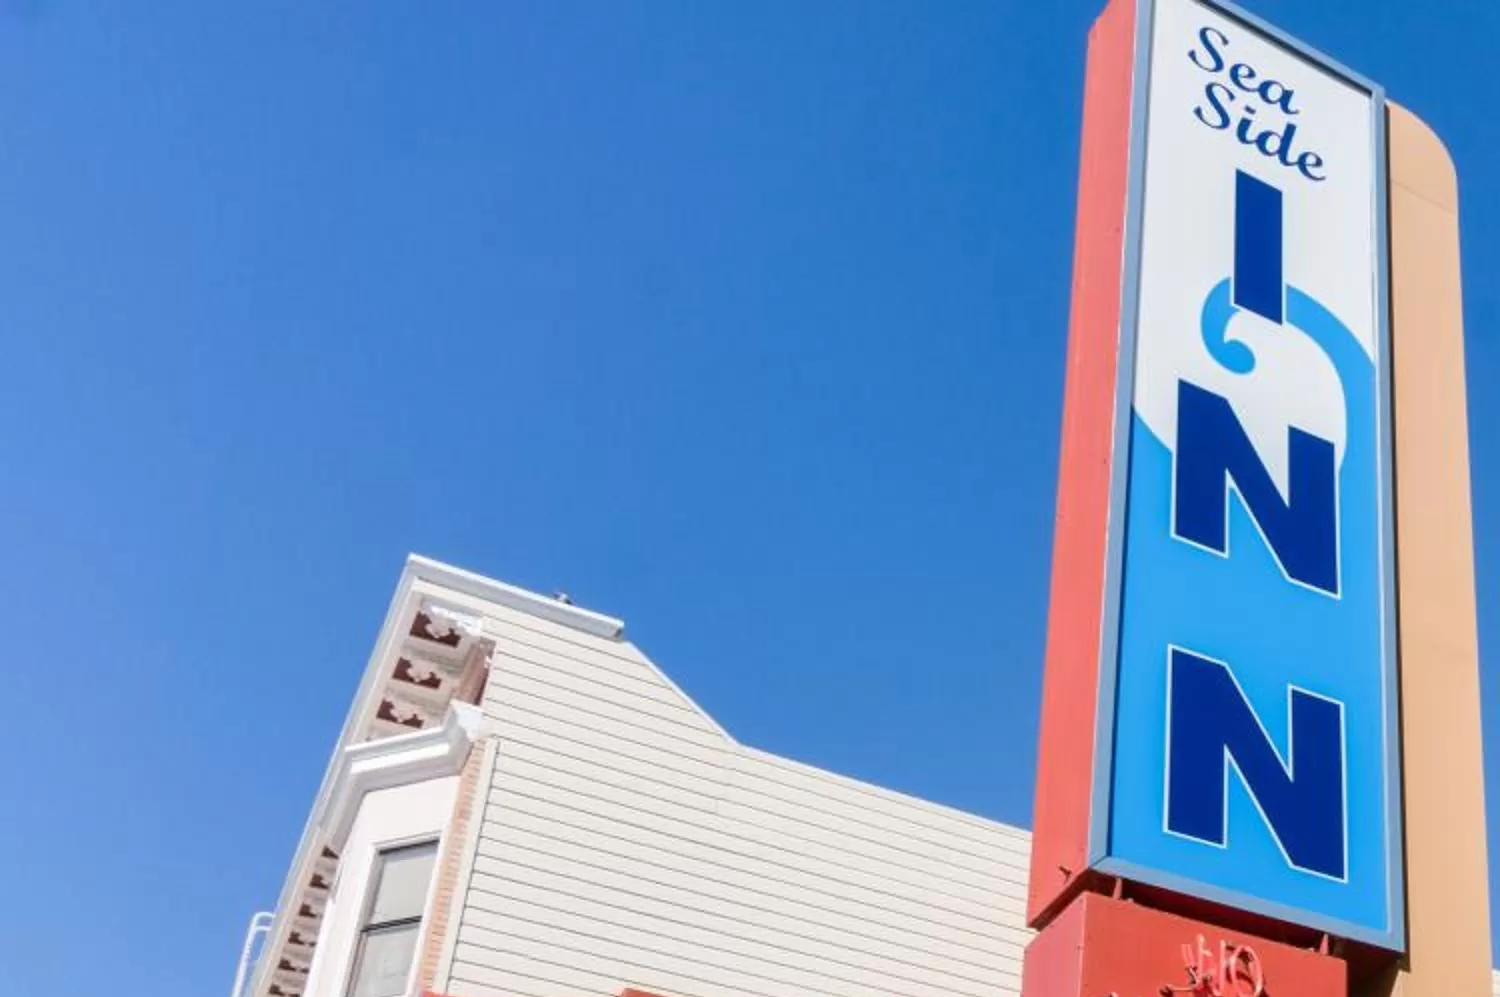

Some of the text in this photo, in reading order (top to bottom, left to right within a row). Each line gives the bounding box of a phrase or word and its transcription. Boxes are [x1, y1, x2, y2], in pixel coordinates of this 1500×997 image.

[1188, 27, 1300, 115] Sea
[1193, 82, 1326, 181] Side
[1163, 168, 1348, 882] INN
